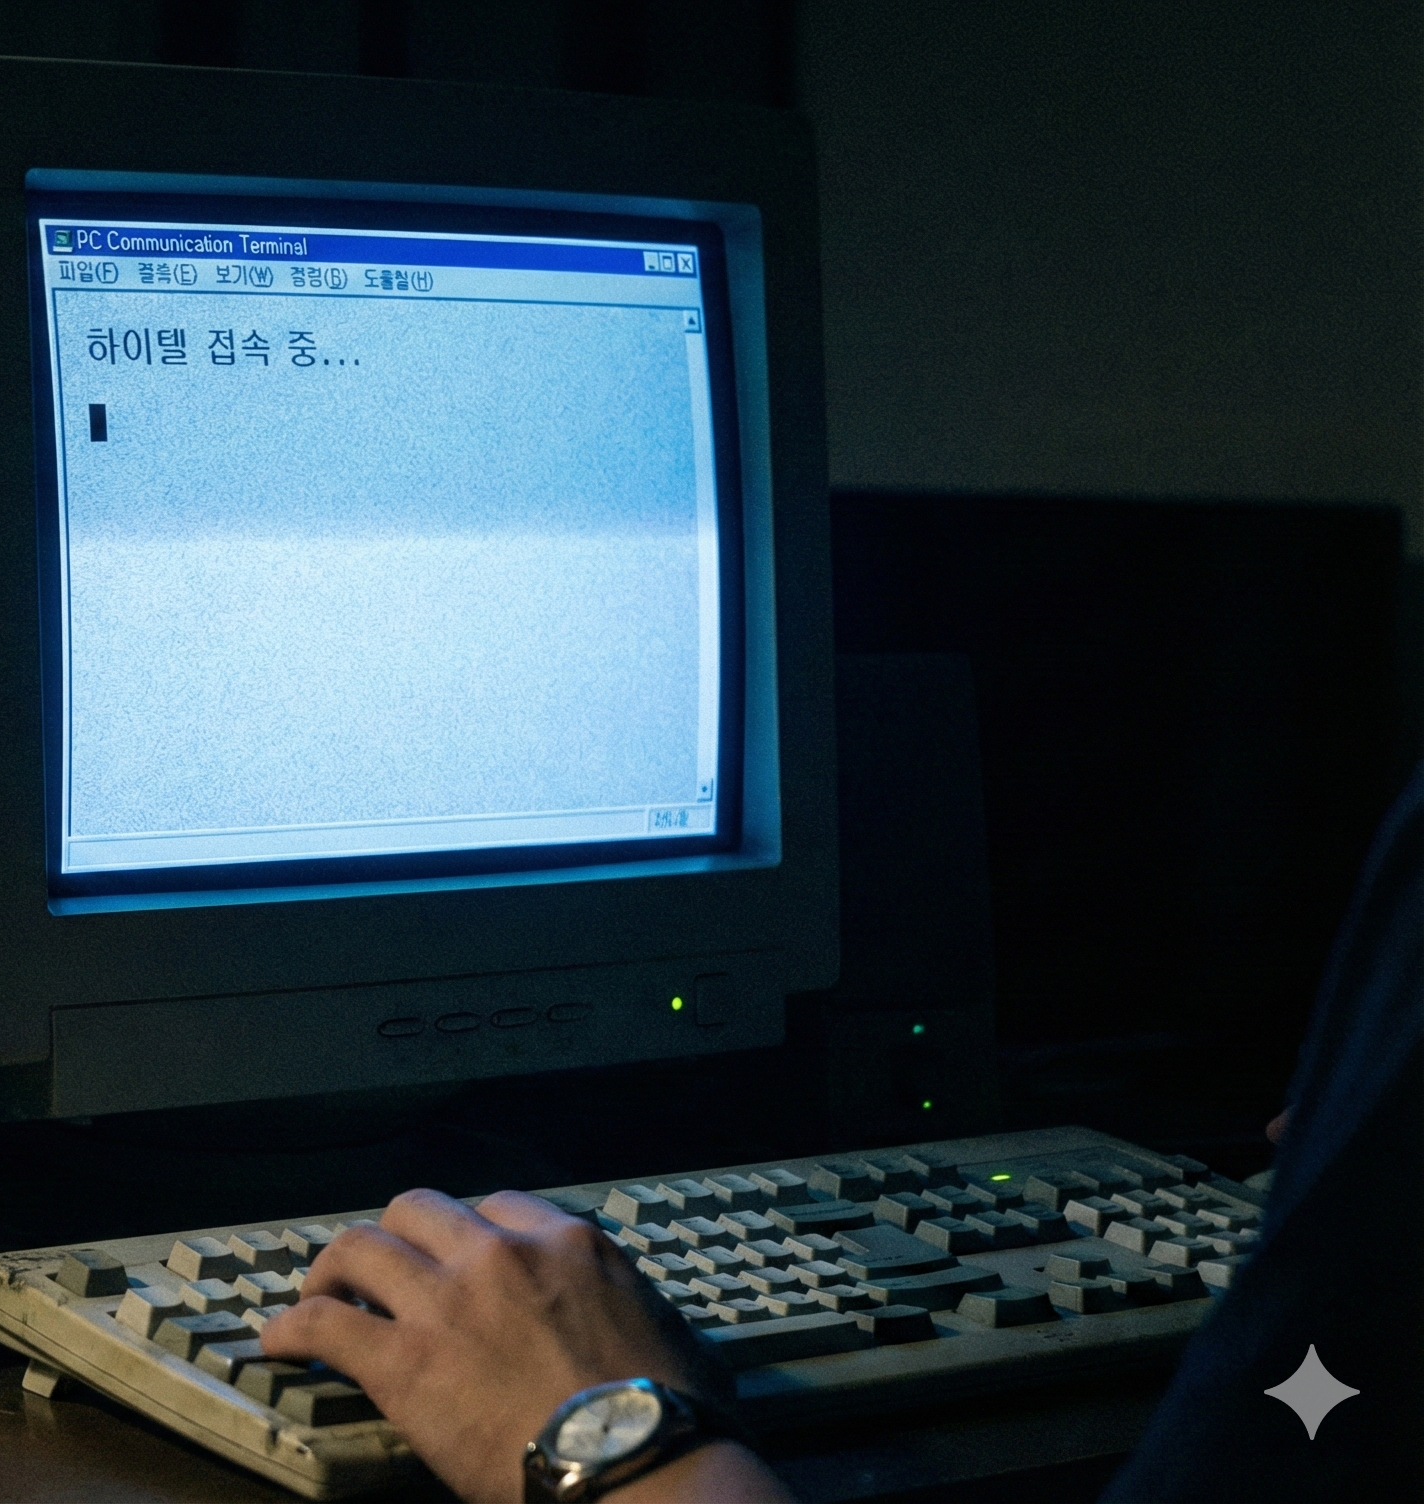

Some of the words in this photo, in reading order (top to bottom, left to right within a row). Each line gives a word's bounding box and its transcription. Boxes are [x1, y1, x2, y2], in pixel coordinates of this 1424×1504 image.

[77, 229, 102, 250] PC
[107, 230, 233, 254] Communication
[239, 233, 308, 256] Terminal
[86, 327, 188, 366] 하이텔
[208, 328, 271, 366] 접속
[288, 330, 361, 367] 중...
